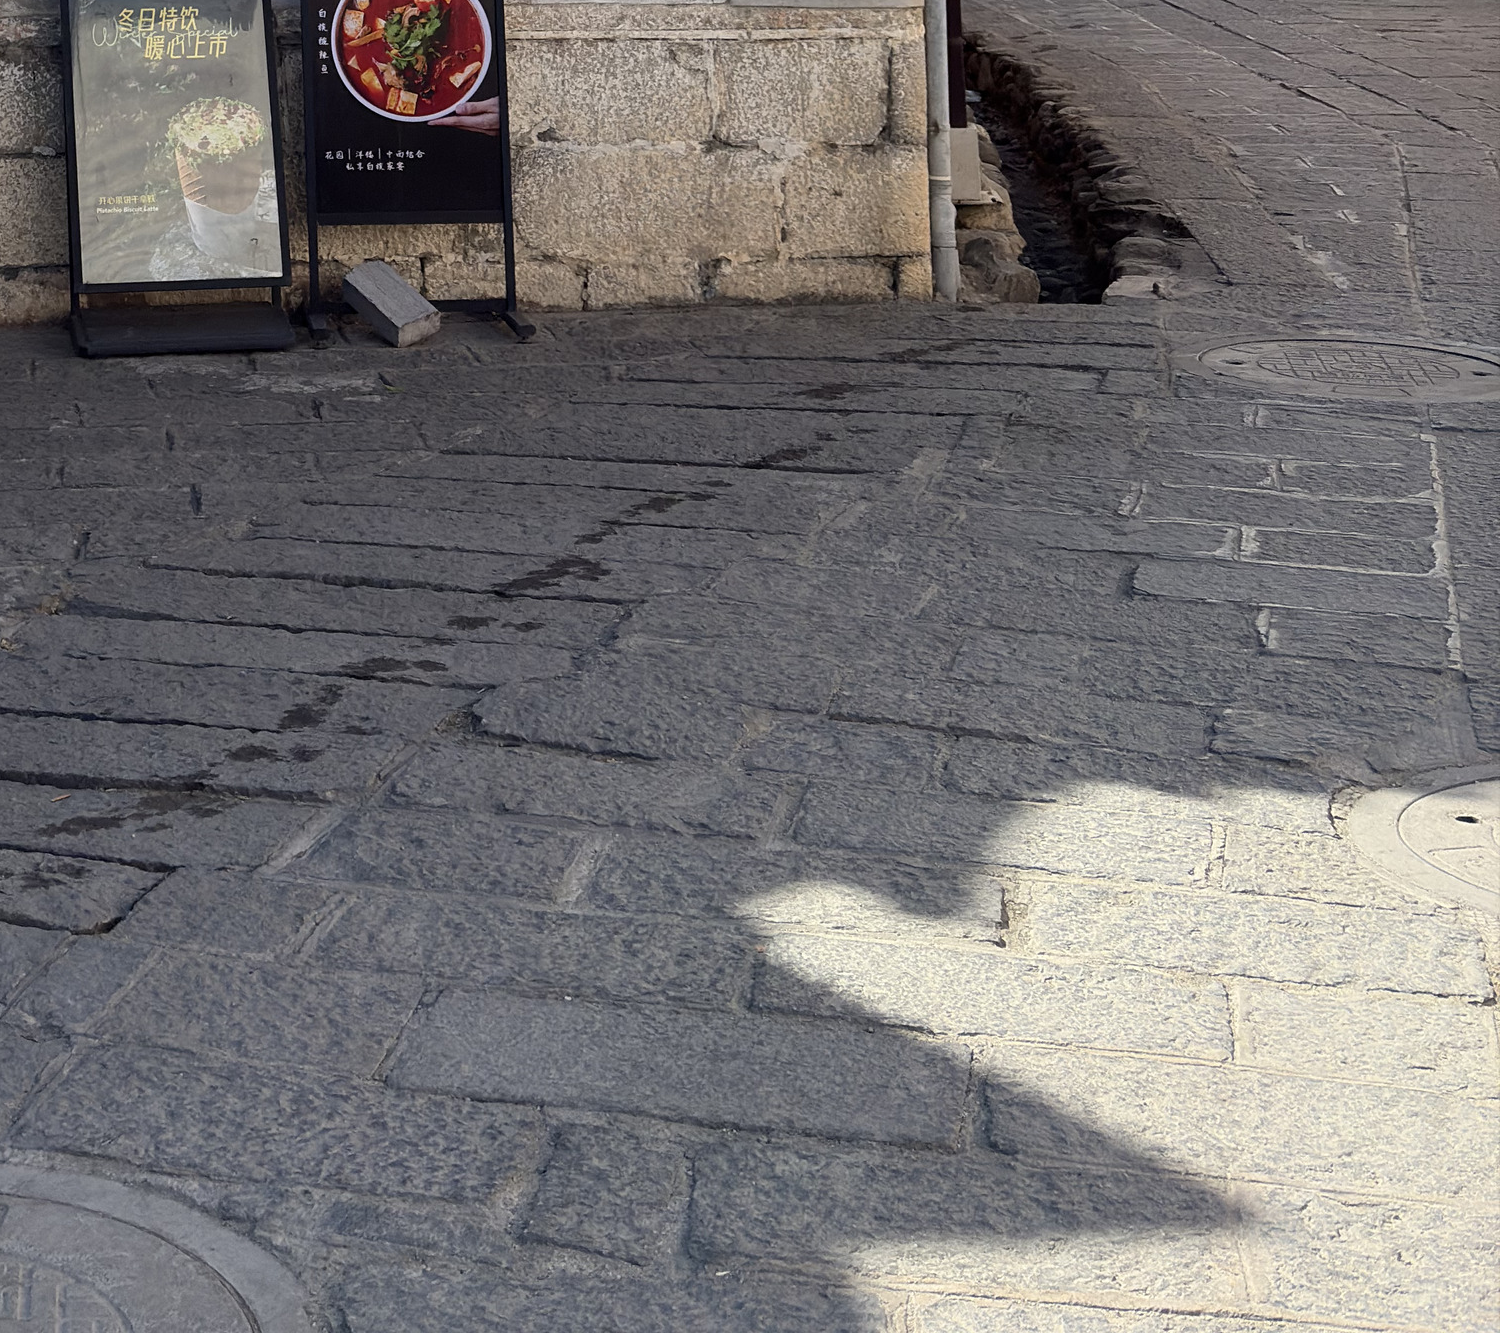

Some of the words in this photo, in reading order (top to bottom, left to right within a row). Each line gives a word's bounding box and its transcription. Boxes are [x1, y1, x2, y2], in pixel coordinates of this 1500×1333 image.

[118, 6, 199, 32] 冬日特饮
[144, 35, 228, 60] 暖心上市
